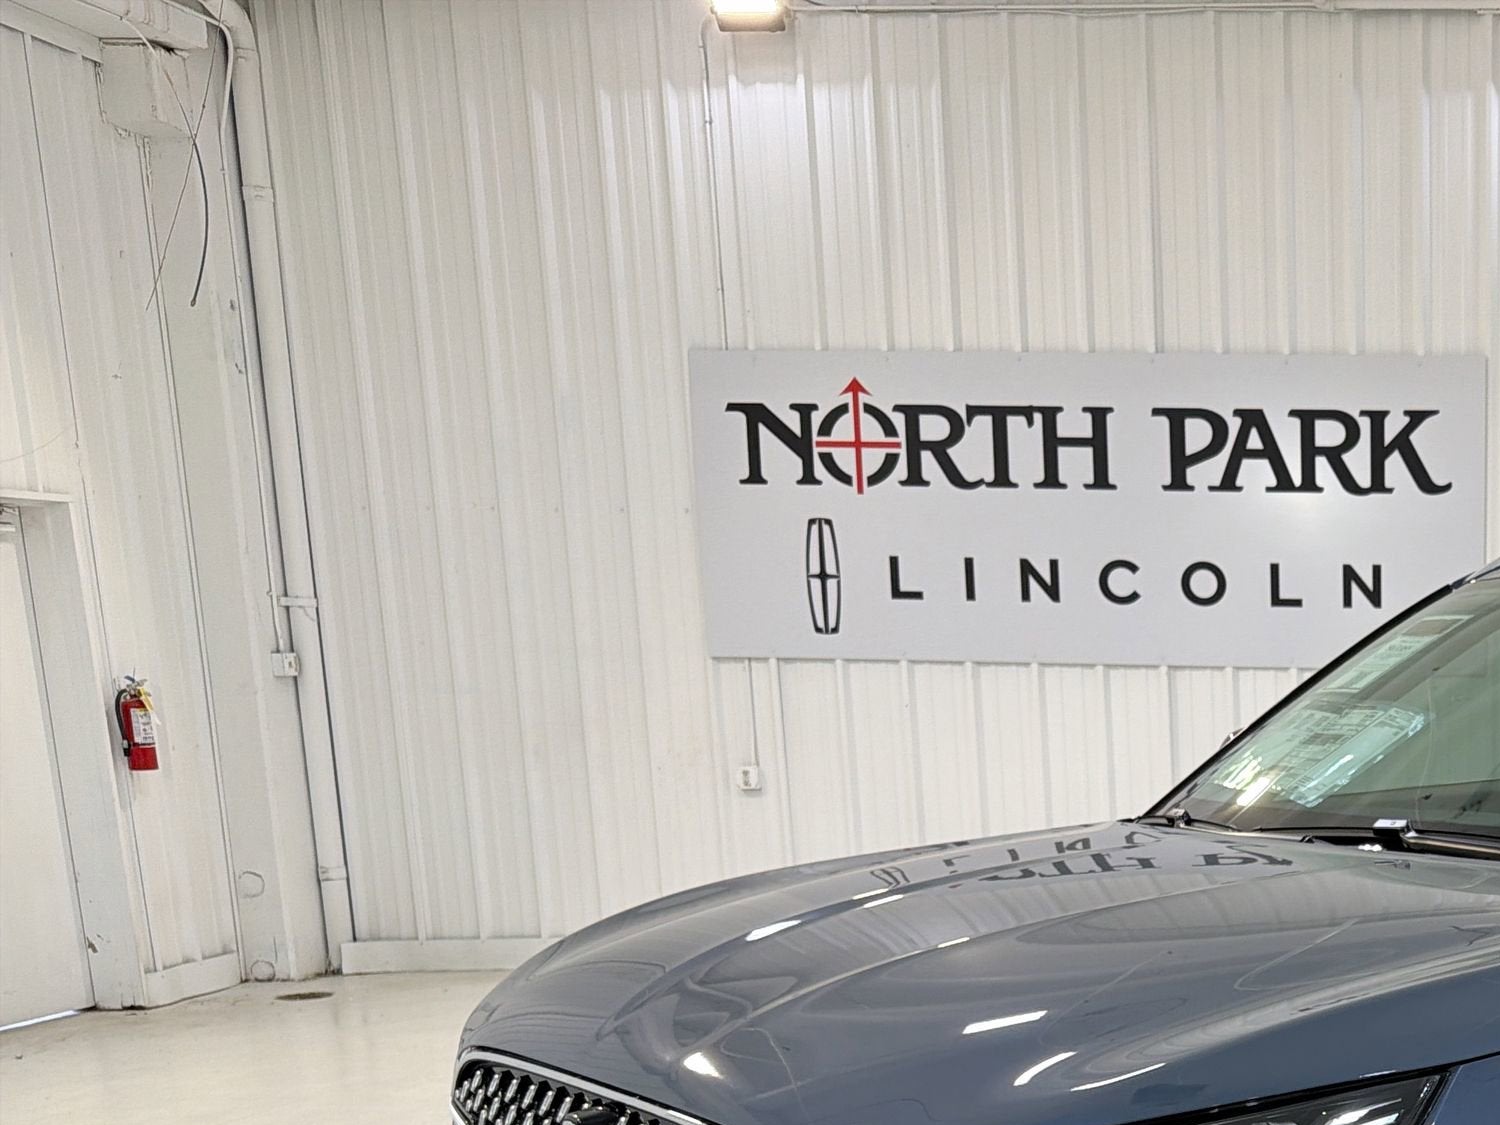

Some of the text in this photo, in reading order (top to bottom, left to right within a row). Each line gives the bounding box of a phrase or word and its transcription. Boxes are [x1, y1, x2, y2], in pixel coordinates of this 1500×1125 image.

[725, 400, 1453, 497] NORTH PARK
[889, 555, 1384, 609] LINCOLN
